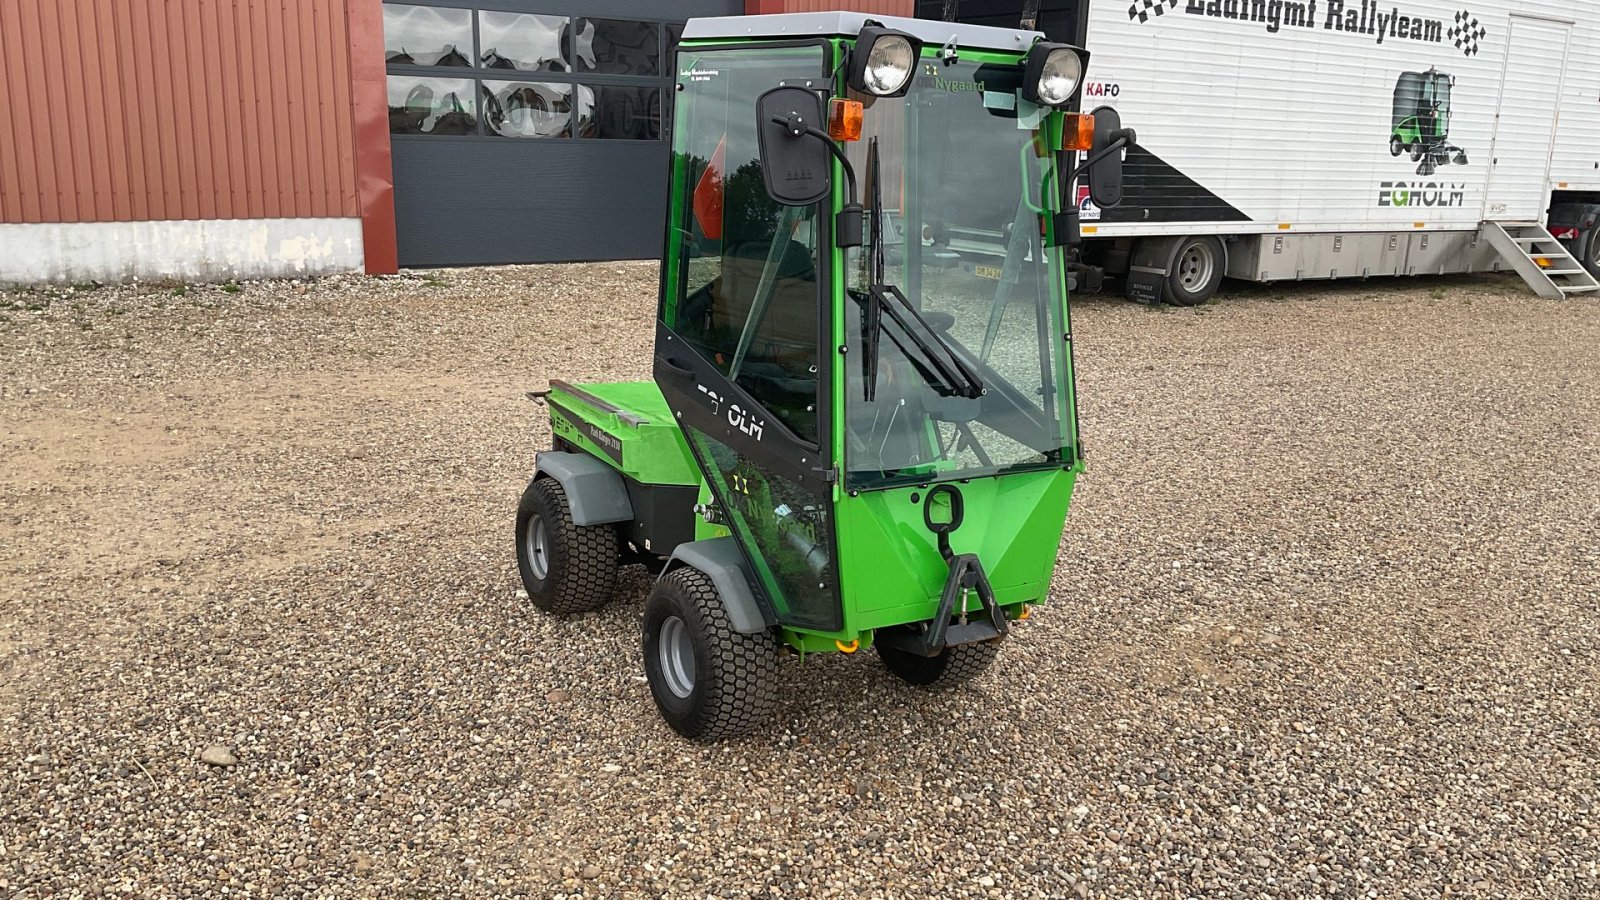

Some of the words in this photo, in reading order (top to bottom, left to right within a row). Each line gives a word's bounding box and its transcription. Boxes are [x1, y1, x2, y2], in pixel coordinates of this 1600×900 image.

[1324, 0, 1442, 44] Rallyteam
[1086, 82, 1120, 97] KAFO
[1378, 182, 1465, 206] EGHOLM
